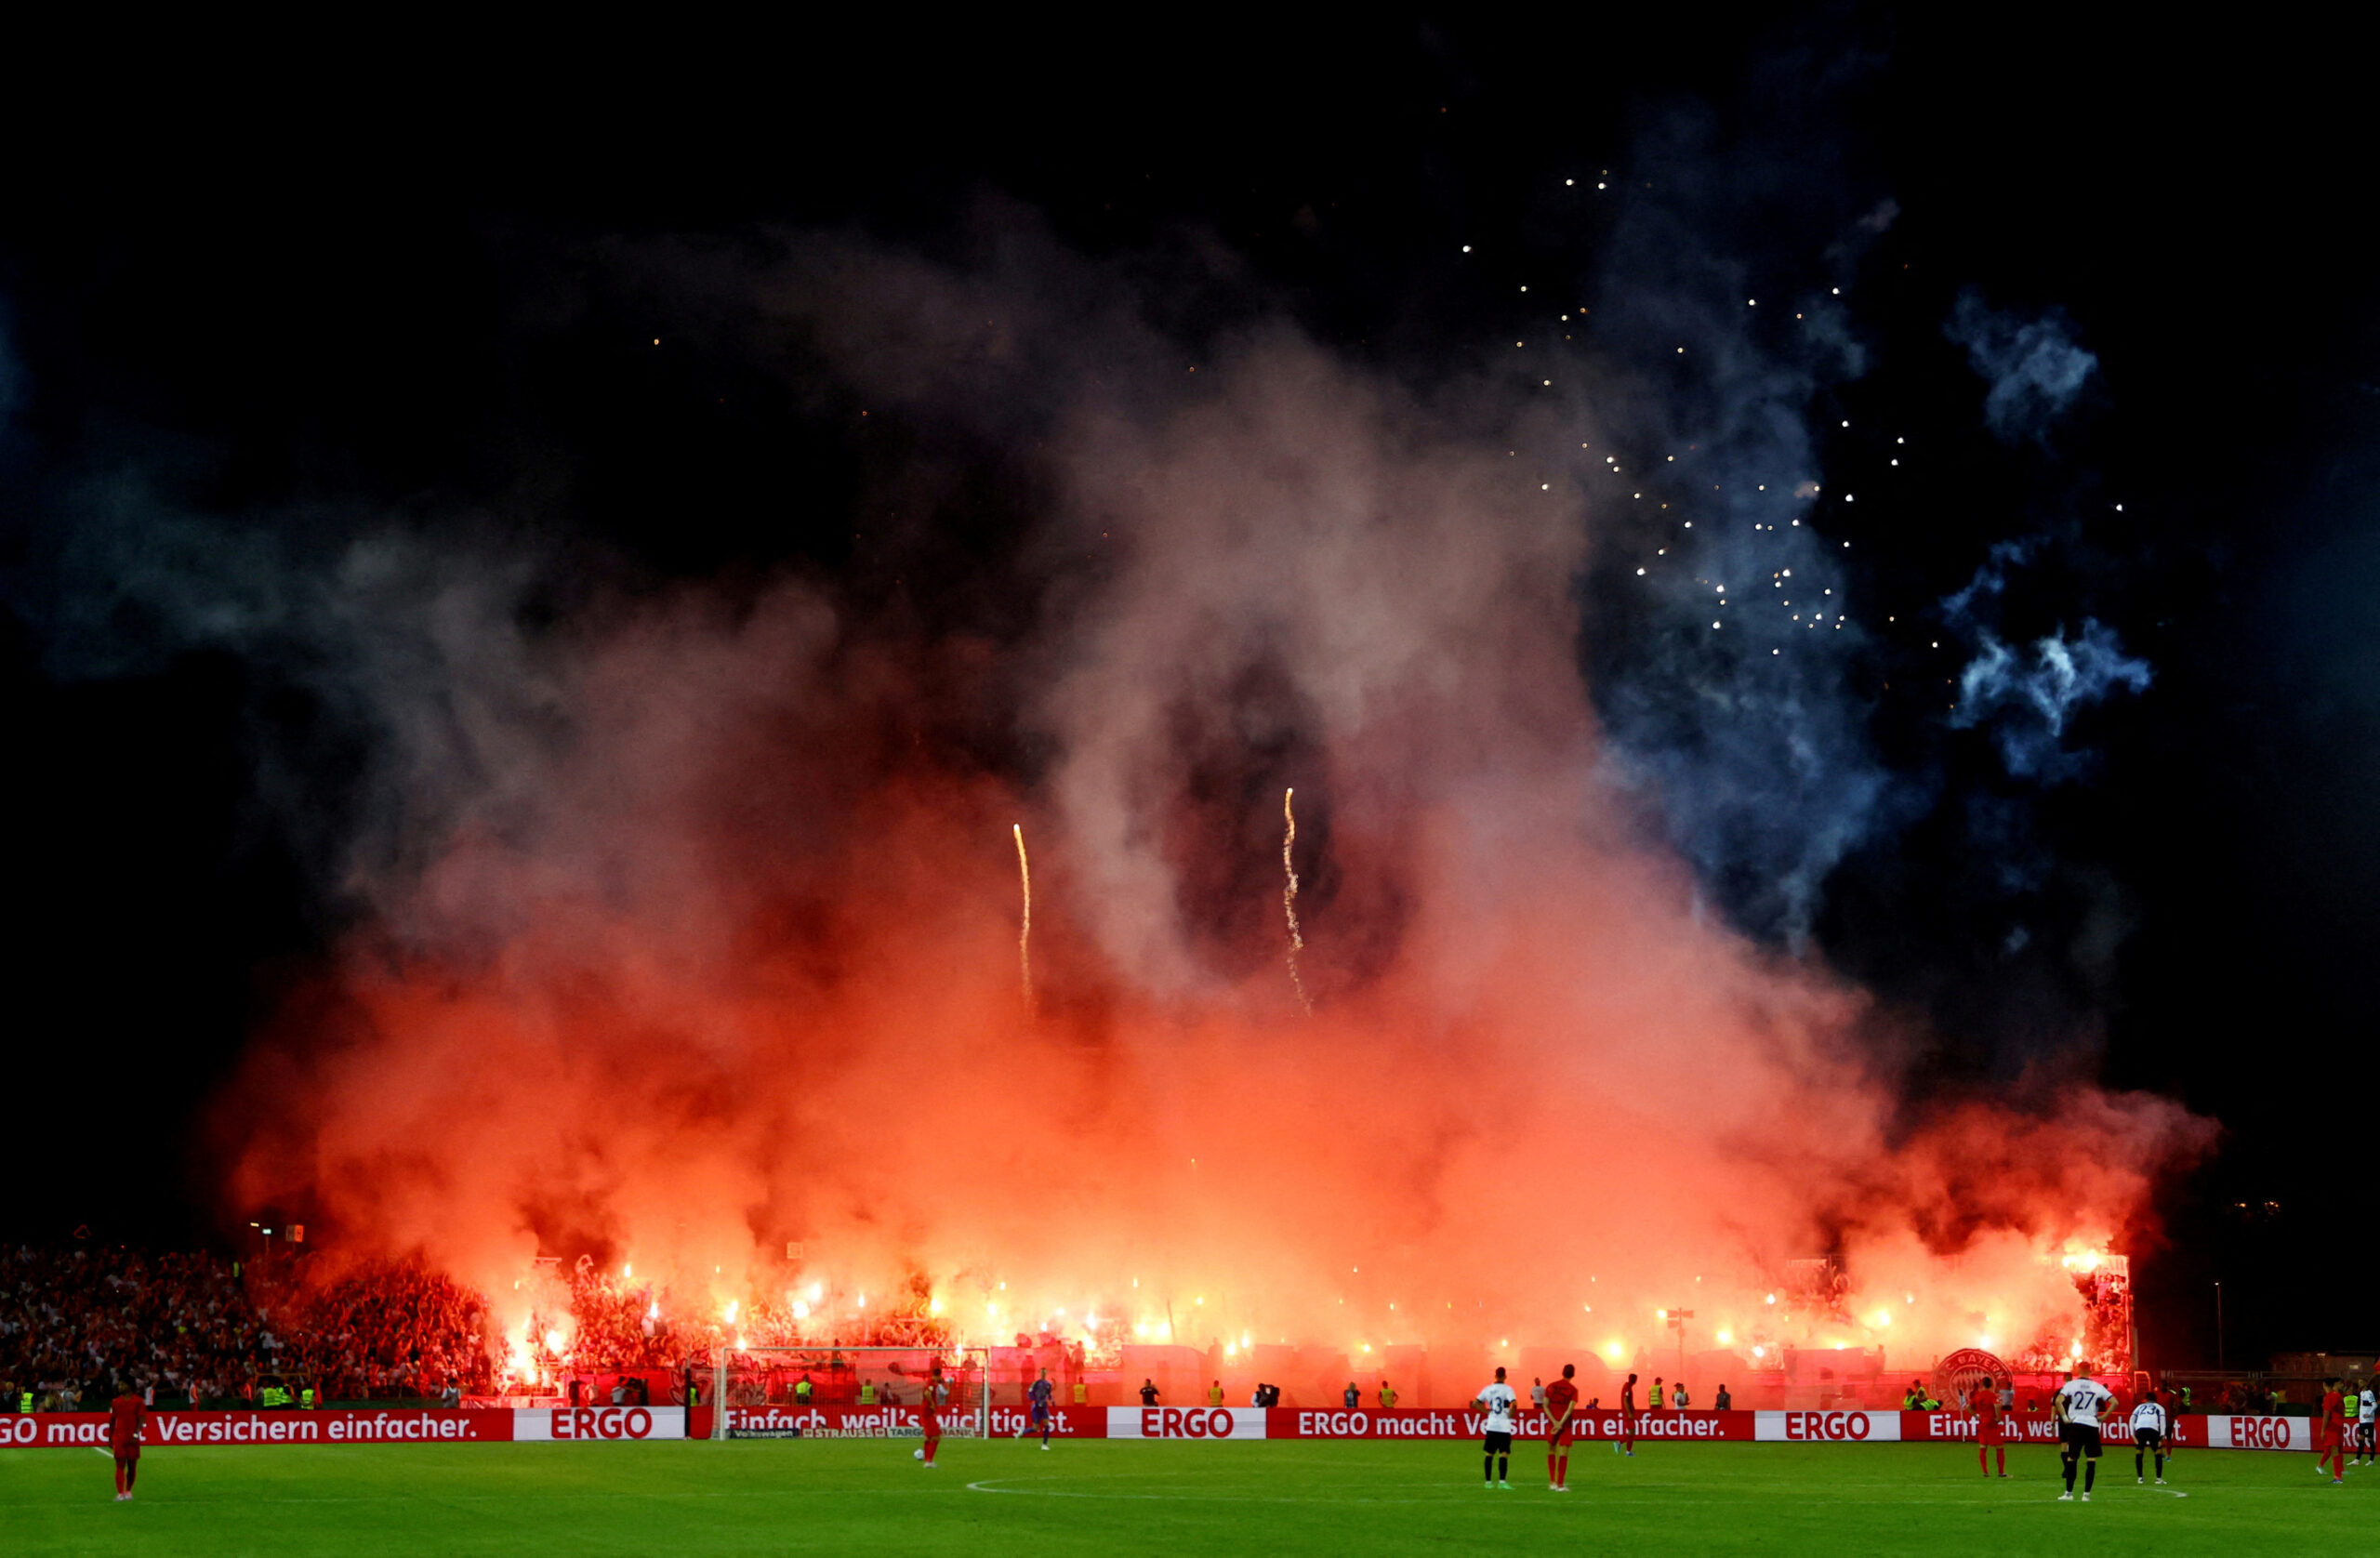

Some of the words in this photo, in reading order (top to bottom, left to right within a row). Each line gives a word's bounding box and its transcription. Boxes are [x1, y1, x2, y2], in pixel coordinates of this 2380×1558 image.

[1957, 1353, 2006, 1380] BAYERN
[2073, 1391, 2096, 1410] 27
[2139, 1405, 2155, 1415] 23
[47, 1422, 147, 1444] mac
[156, 1414, 318, 1441] Versichern
[328, 1413, 478, 1440] einfacher.
[551, 1407, 653, 1439] ERGO
[815, 1429, 873, 1438] STRAUSS
[1046, 1411, 1074, 1433] st.
[1142, 1408, 1234, 1438] ERGO
[1299, 1412, 1368, 1435] ERGO
[1376, 1412, 1457, 1435] macht
[1463, 1412, 1595, 1436] Vesichrn
[1786, 1412, 1870, 1440] ERGO
[1929, 1414, 2023, 1442] Einfh,
[2230, 1417, 2290, 1448] ERGO
